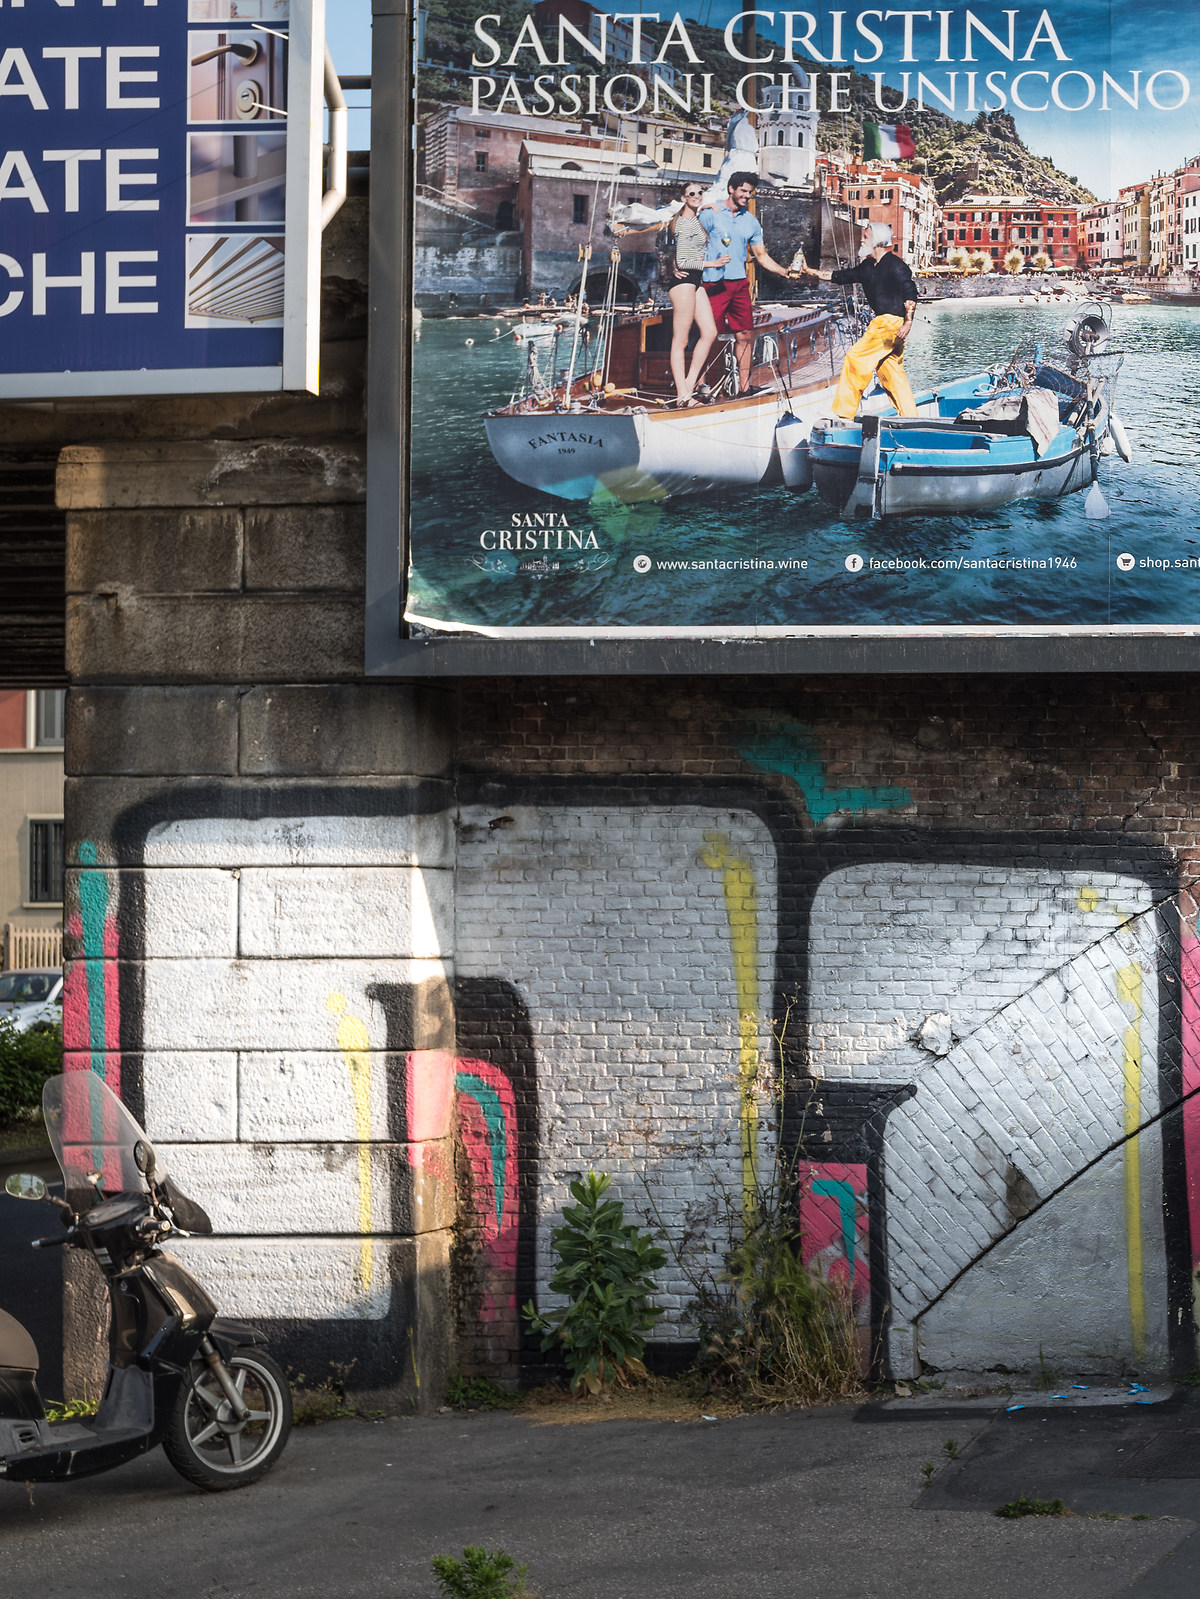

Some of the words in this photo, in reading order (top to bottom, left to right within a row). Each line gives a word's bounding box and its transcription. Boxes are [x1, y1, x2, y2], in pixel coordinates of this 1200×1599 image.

[472, 13, 704, 68] SANTA
[724, 8, 1072, 63] CRISTINA
[469, 73, 711, 117] PASSIONI
[736, 71, 852, 114] CHE
[857, 69, 1190, 112] UNISCONO
[528, 431, 604, 449] FANTASIA
[511, 512, 569, 527] SANTA
[480, 530, 600, 550] CRISTINA
[656, 557, 808, 570] www.santacristina.wine
[869, 556, 1078, 570] facebook.com/santacristina1946
